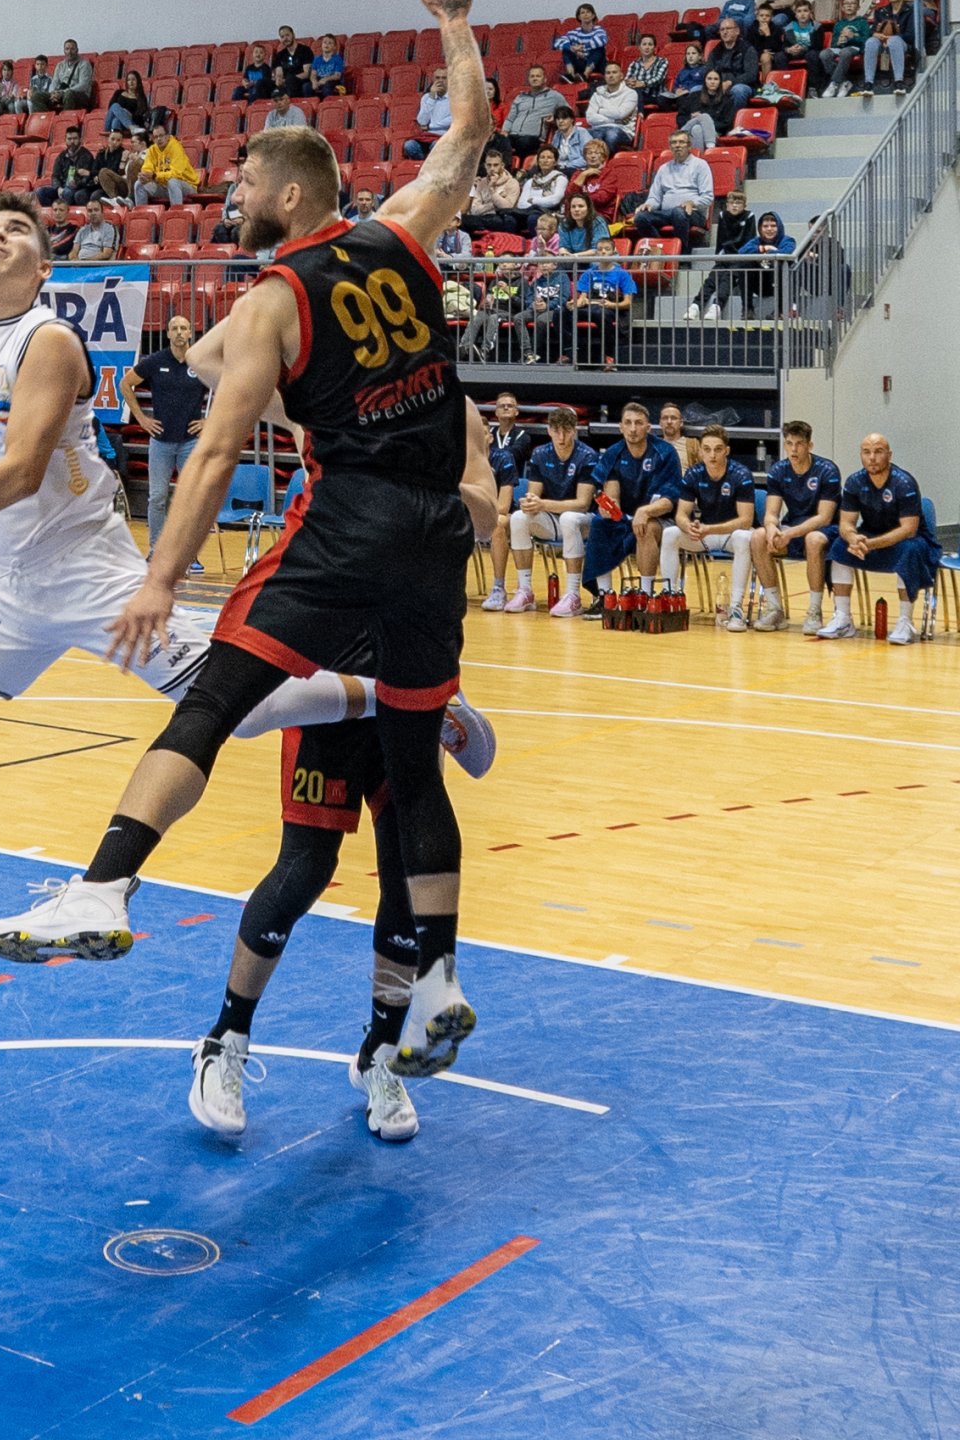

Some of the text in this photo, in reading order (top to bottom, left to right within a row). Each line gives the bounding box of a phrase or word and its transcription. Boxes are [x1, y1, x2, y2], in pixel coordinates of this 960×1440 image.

[330, 268, 431, 369] 99
[358, 384, 446, 427] SPEDITION
[167, 644, 191, 668] JAKO
[292, 767, 324, 805] 20
